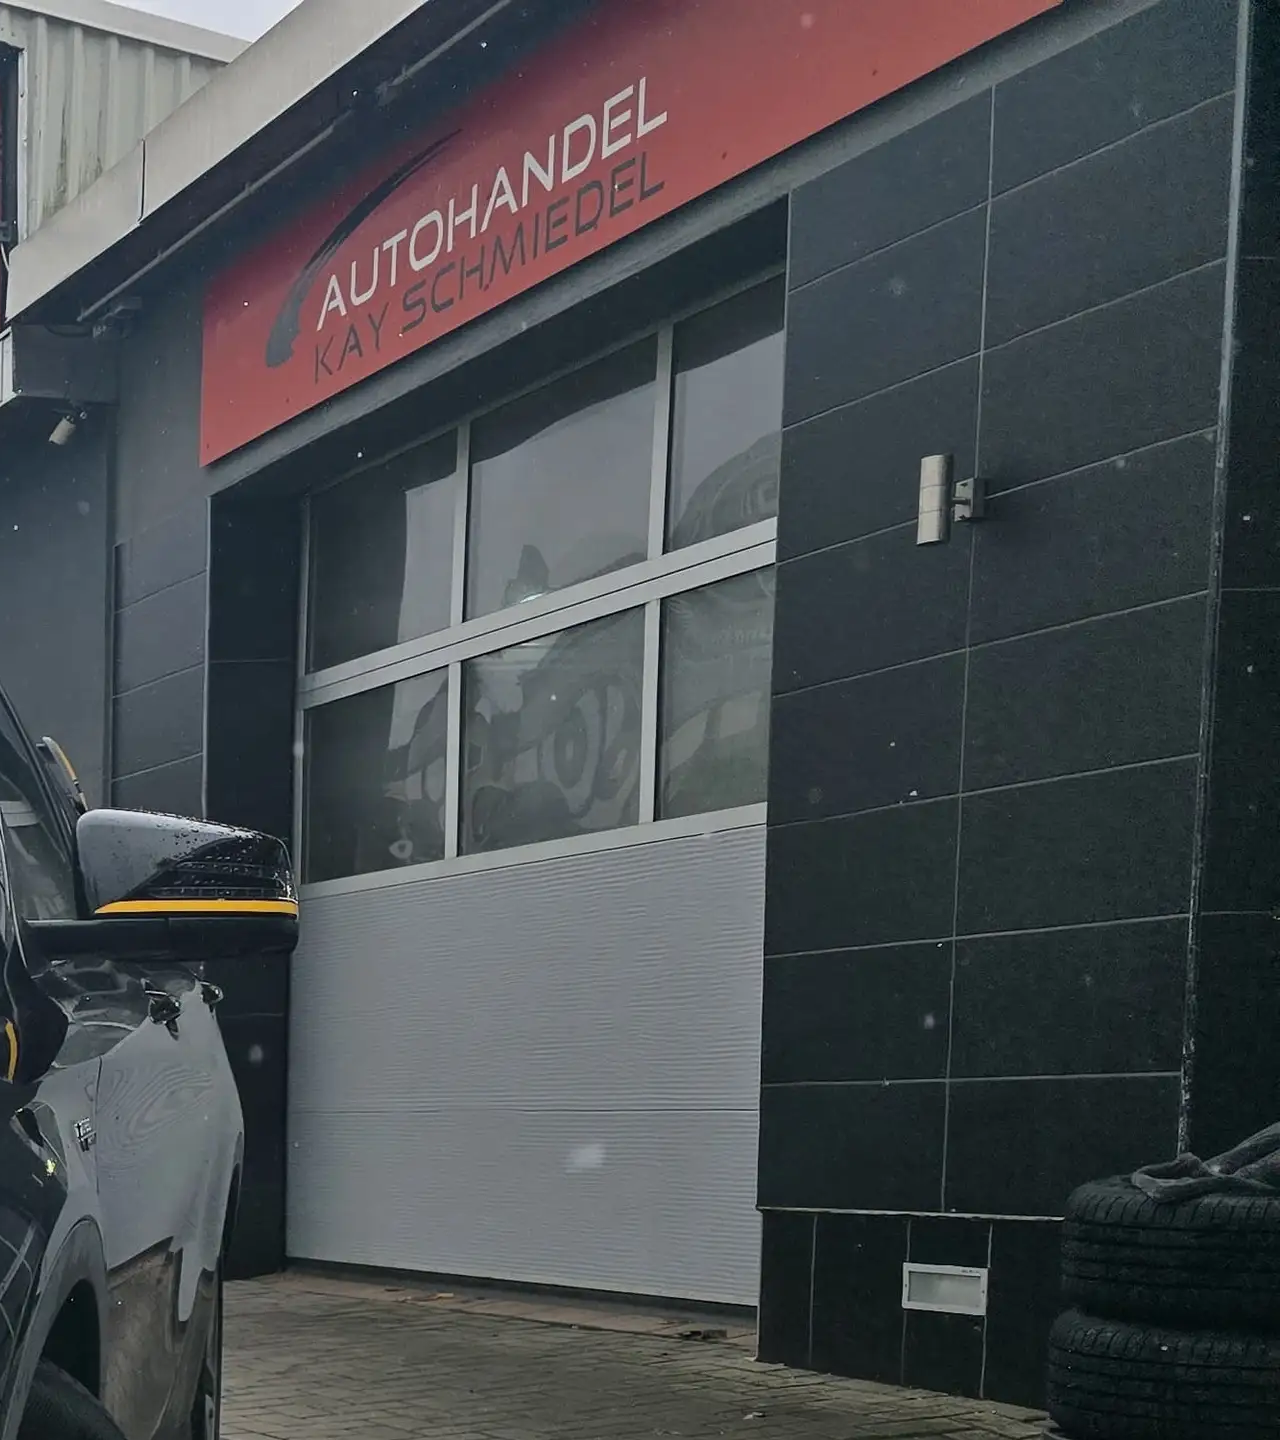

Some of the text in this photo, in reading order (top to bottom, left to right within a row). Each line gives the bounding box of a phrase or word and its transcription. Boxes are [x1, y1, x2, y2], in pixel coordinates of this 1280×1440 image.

[315, 151, 666, 384] KAY SCHMIEDEL
[317, 76, 668, 332] AUTOHANDEL
